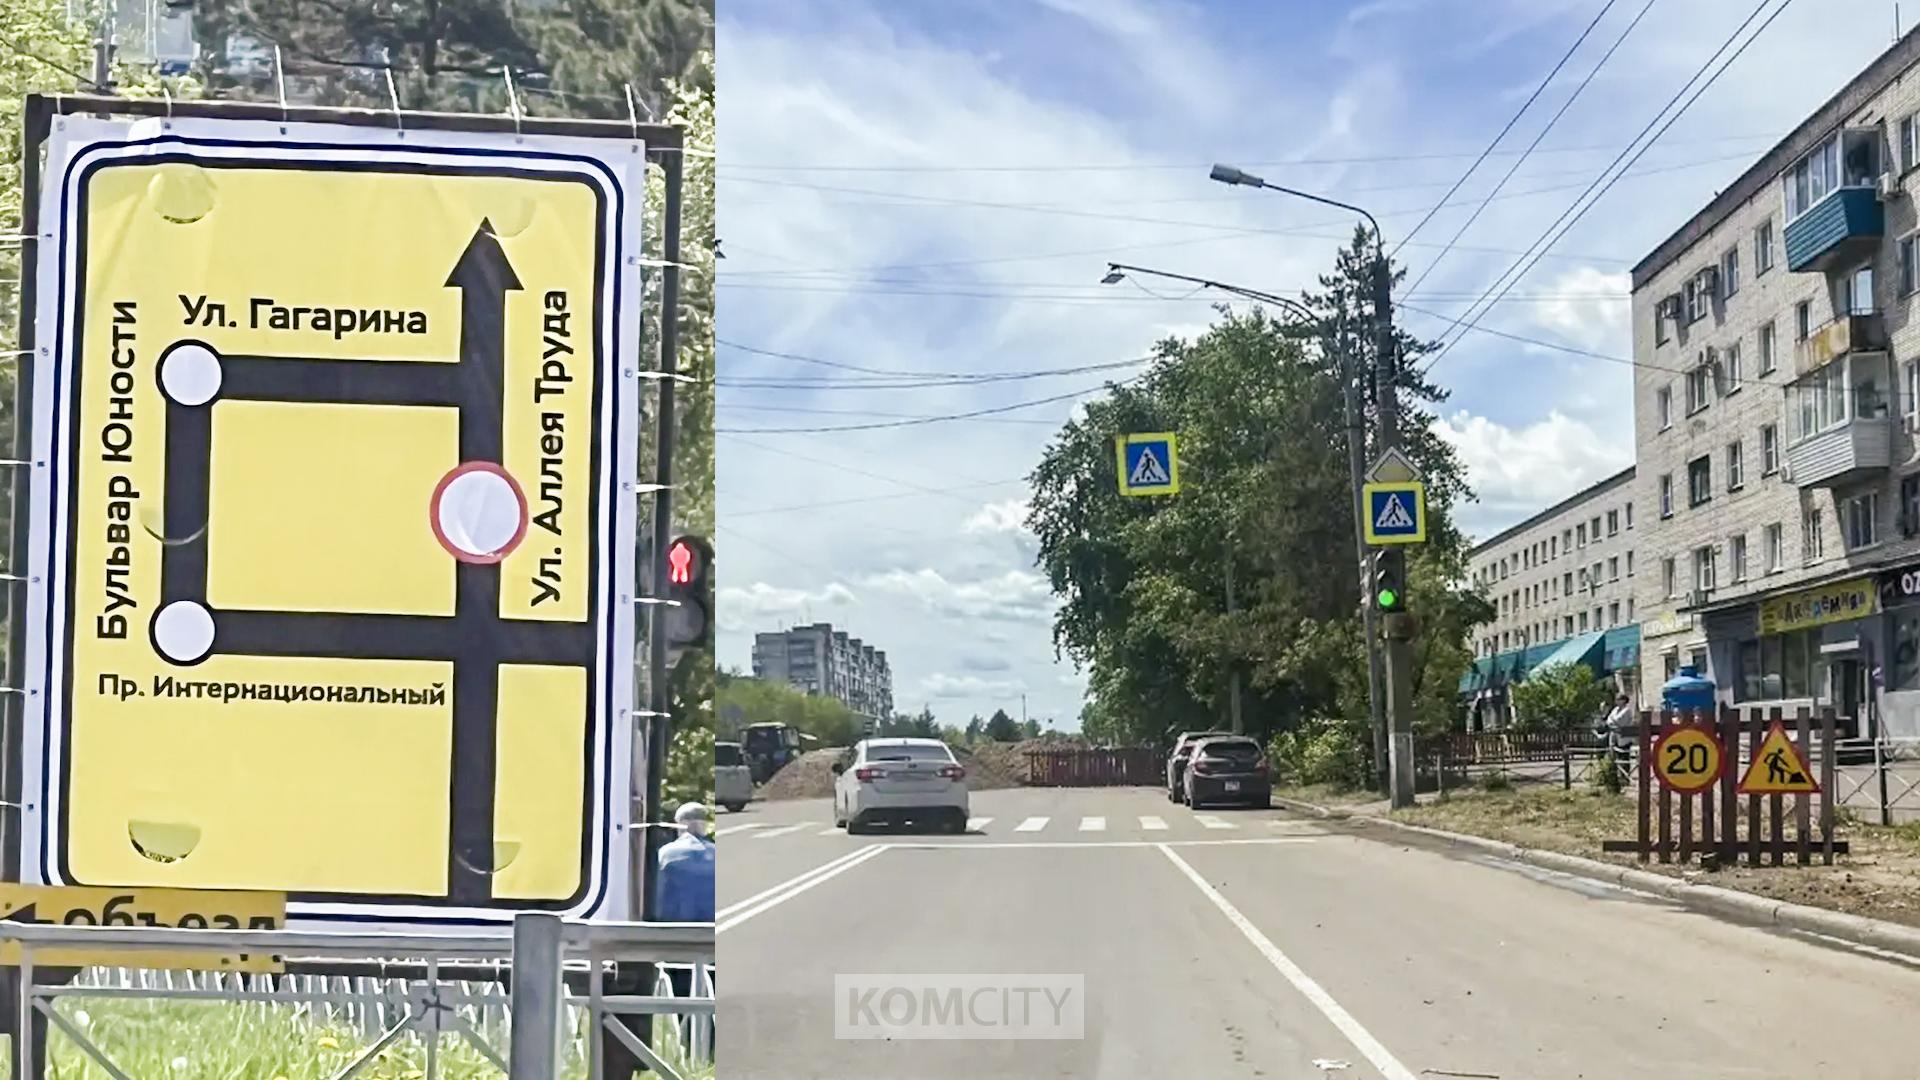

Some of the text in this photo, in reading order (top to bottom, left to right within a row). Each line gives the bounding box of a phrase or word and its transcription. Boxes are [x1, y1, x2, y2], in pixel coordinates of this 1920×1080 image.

[178, 294, 427, 340] Ул. Гагарина
[97, 301, 140, 640] Бульвар Юности
[530, 290, 574, 607] Ул. Аллея Труда
[98, 673, 446, 706] Пр. Интернациональный
[1667, 744, 1707, 774] 20
